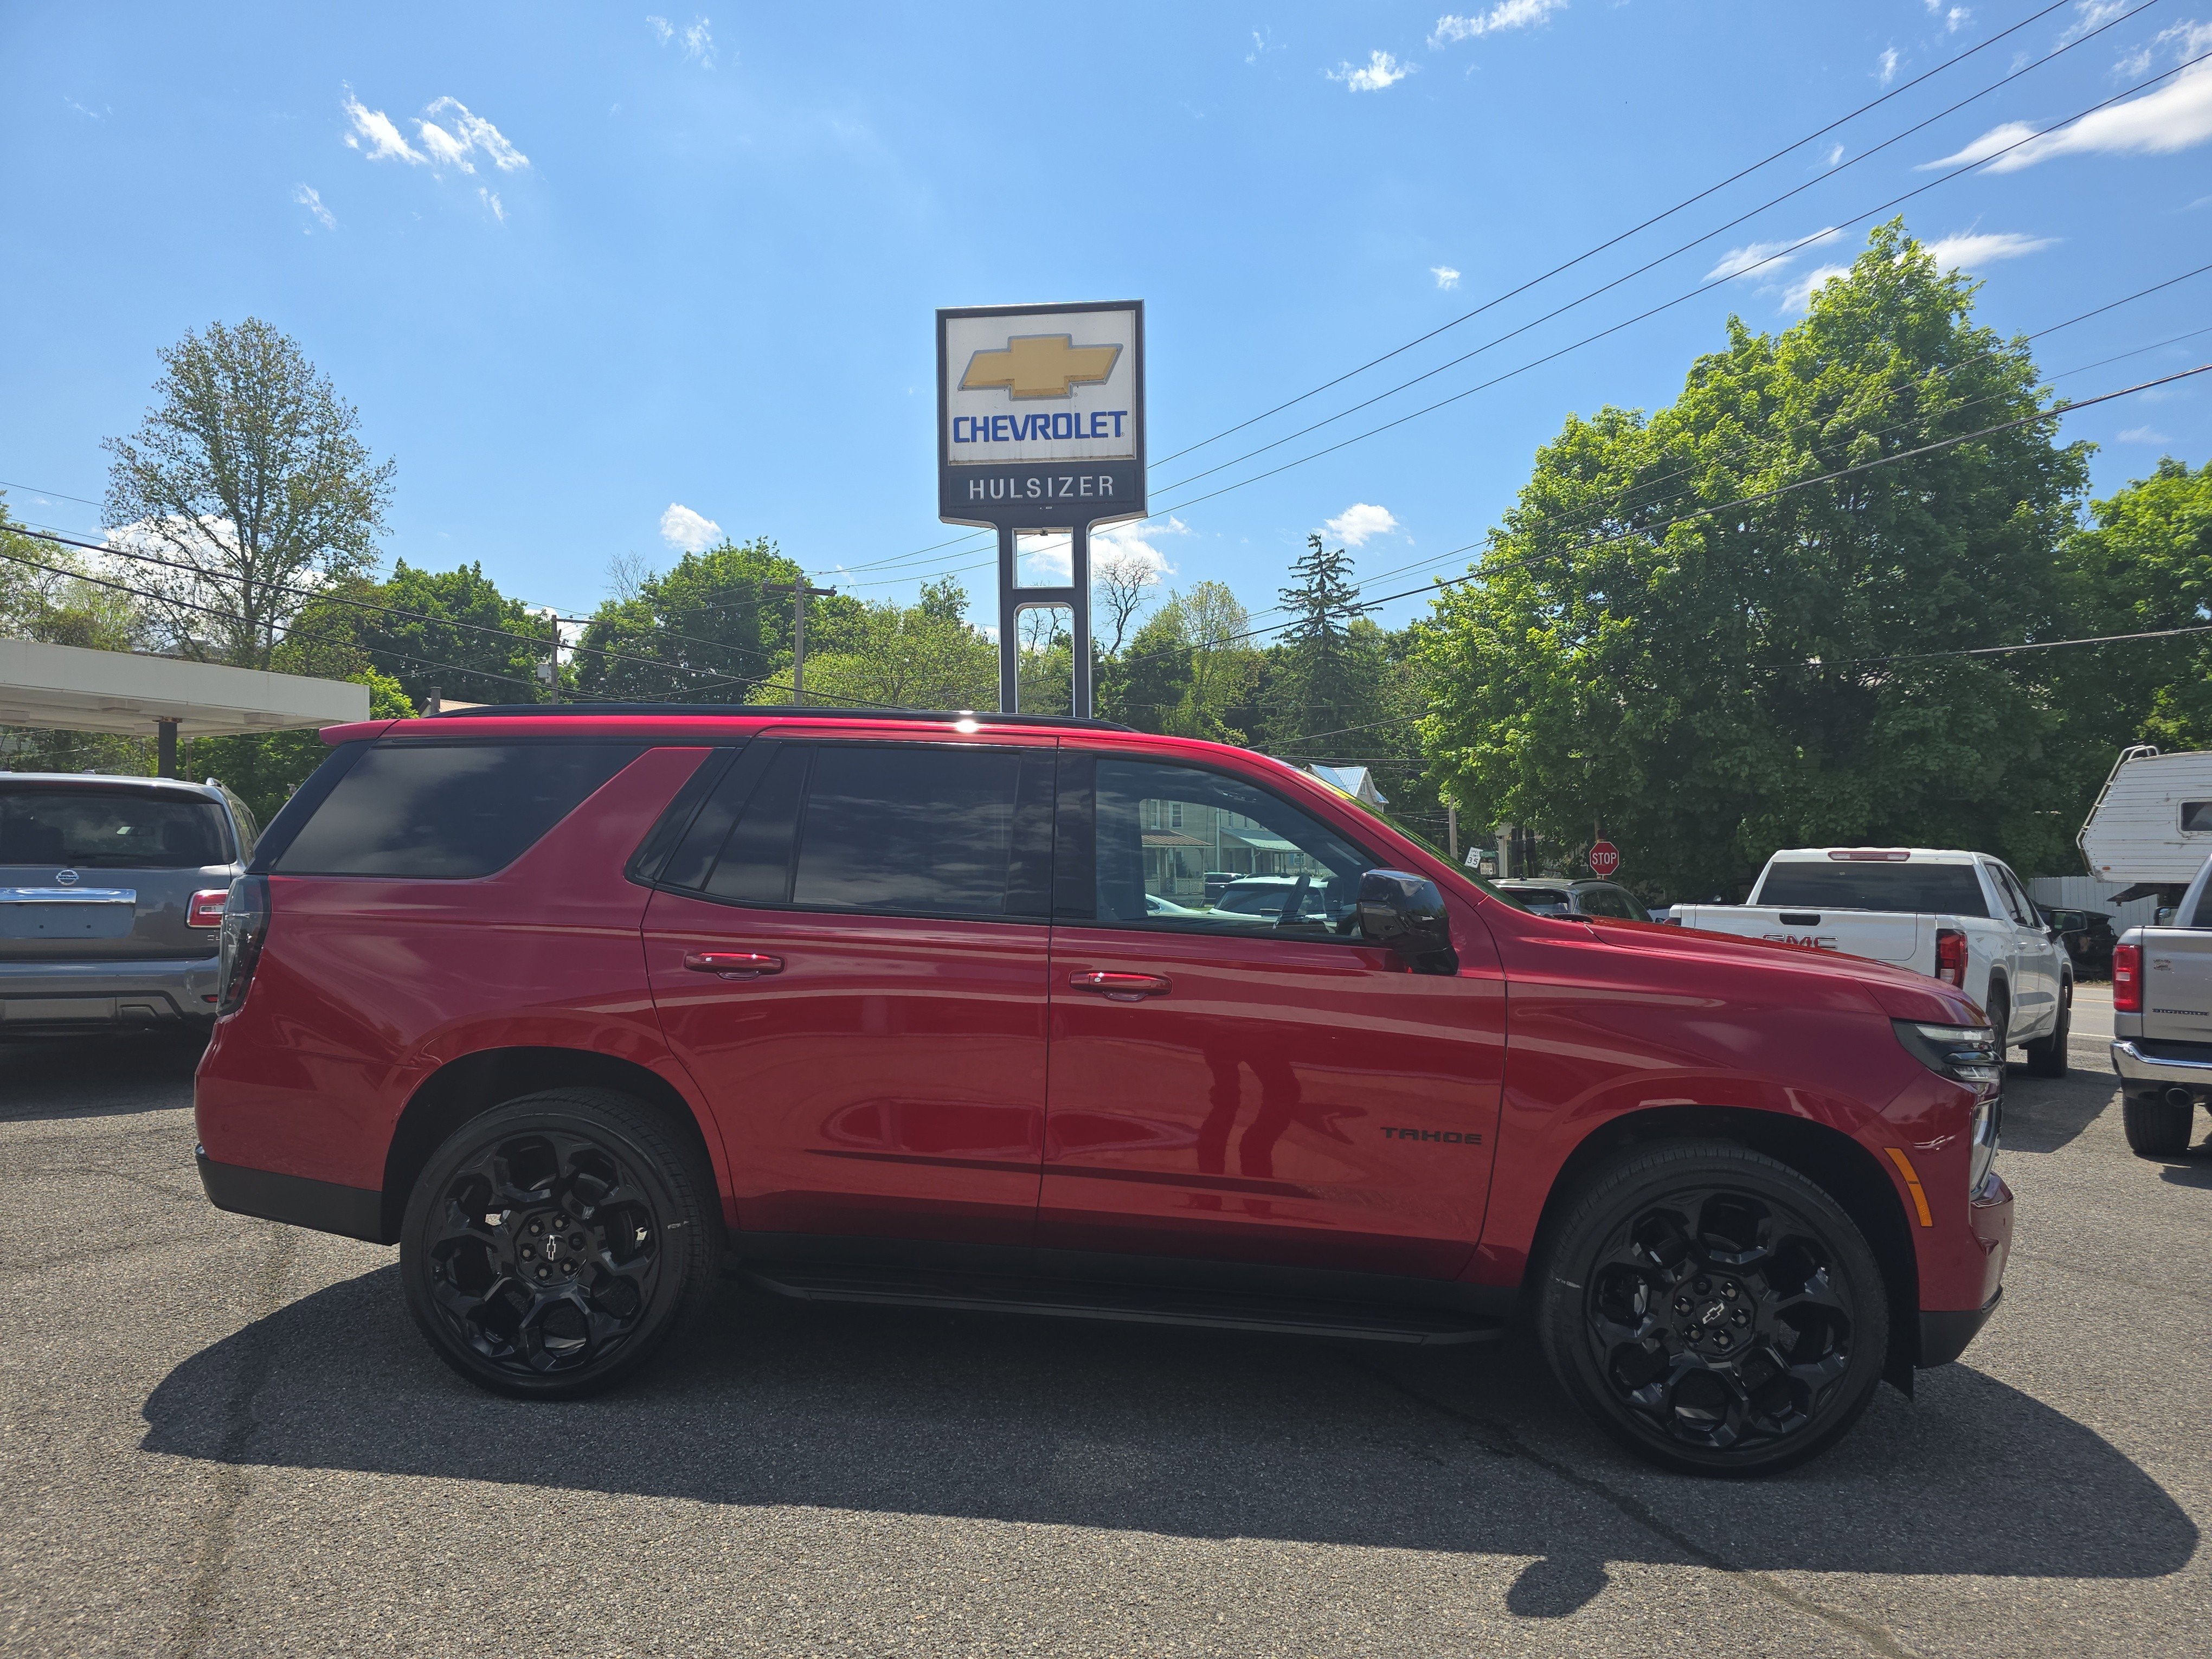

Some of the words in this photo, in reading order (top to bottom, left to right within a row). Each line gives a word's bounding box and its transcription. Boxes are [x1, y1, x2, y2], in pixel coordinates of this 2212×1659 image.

[953, 410, 1128, 443] CHEVROLET
[969, 475, 1114, 500] HULSIZER
[1467, 857, 1478, 865] 35
[1592, 852, 1617, 865] STOP
[1380, 1127, 1482, 1146] TAHOE
